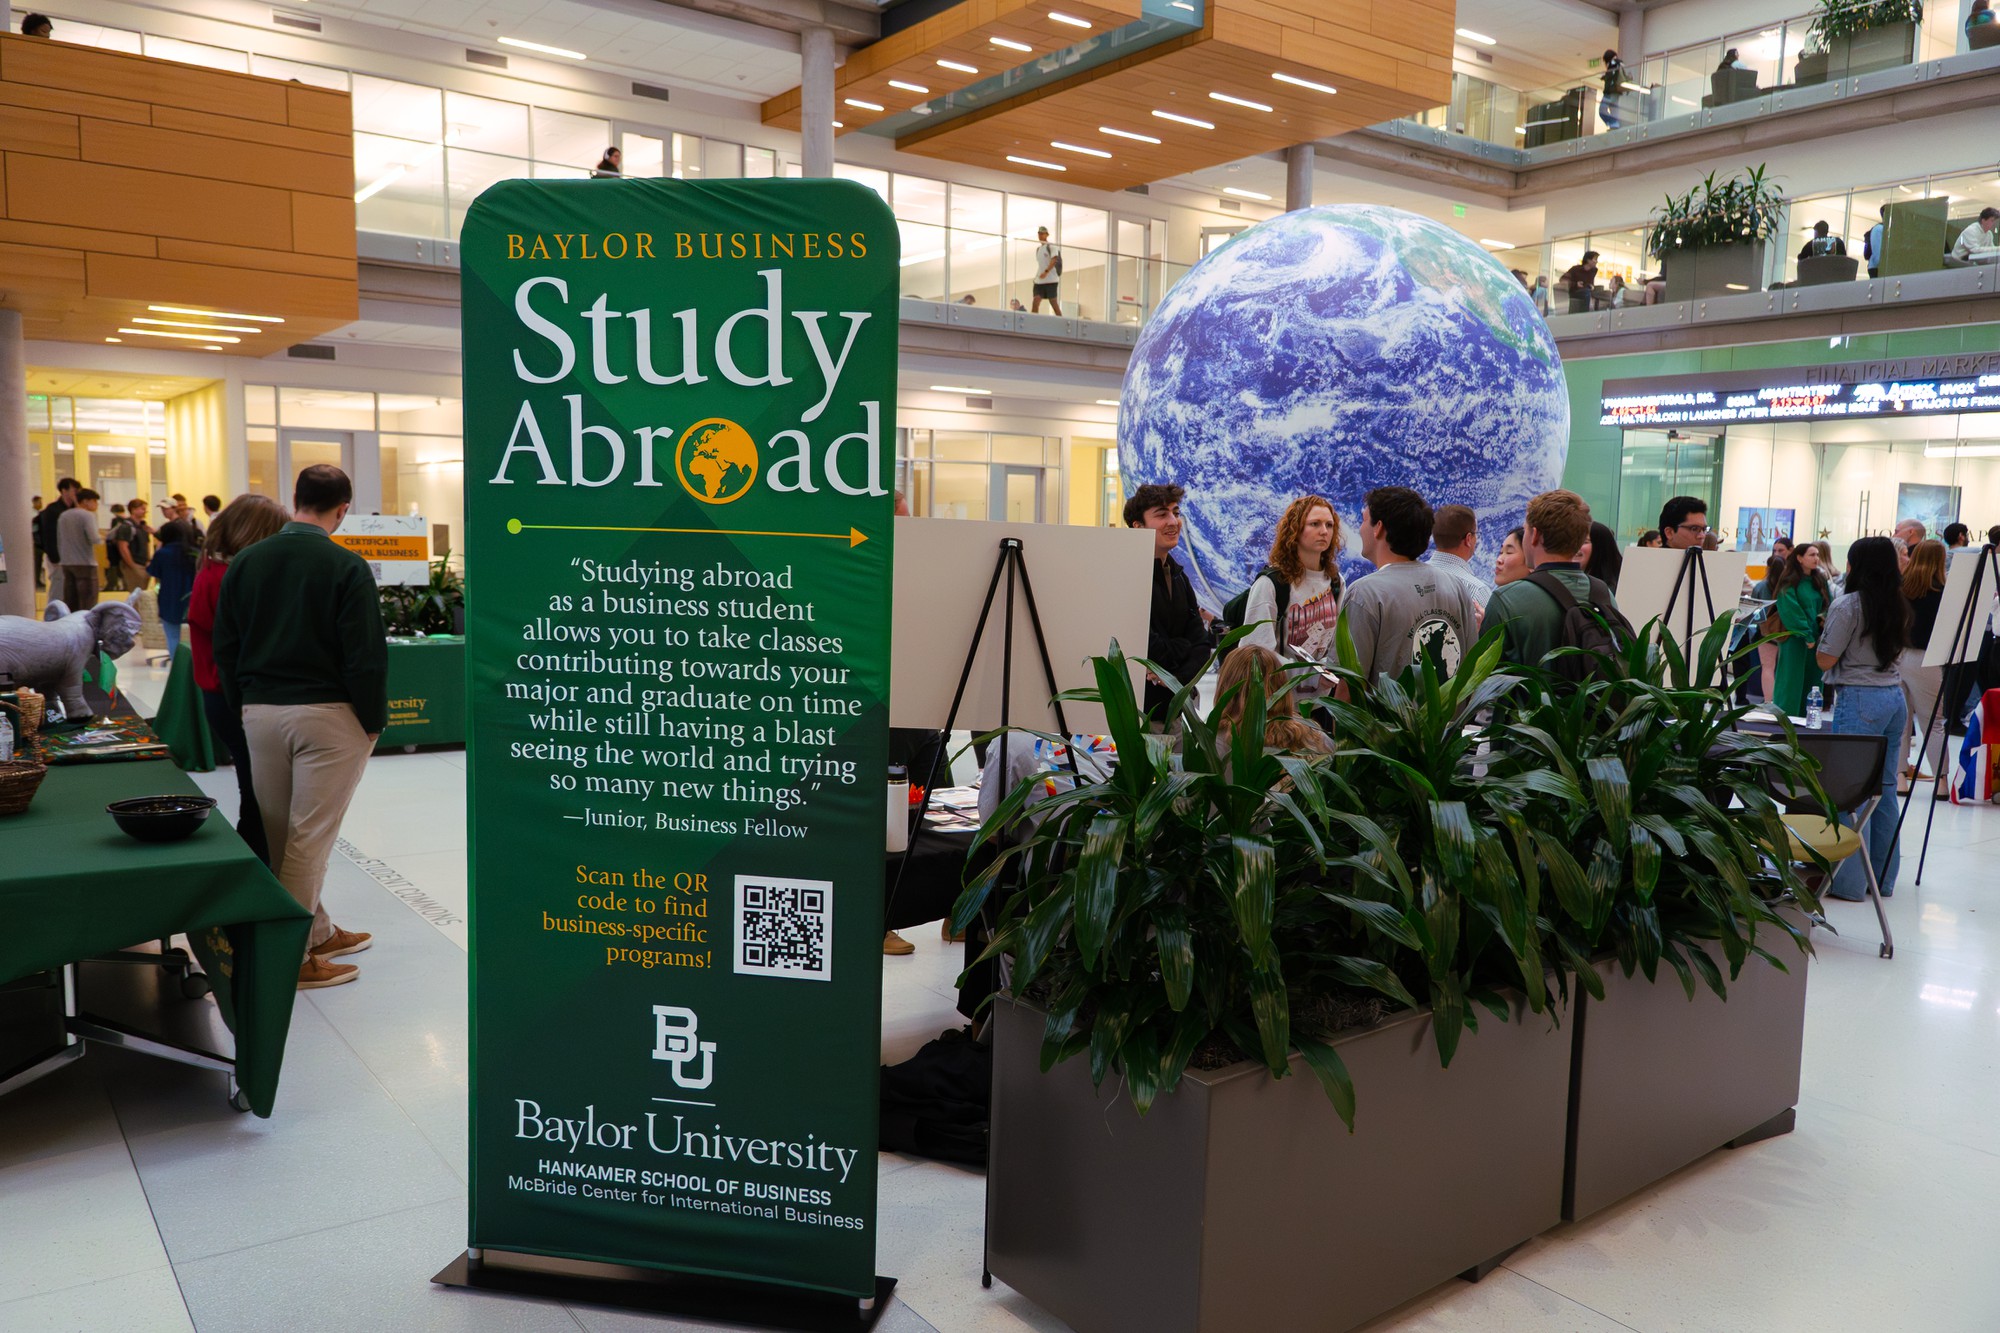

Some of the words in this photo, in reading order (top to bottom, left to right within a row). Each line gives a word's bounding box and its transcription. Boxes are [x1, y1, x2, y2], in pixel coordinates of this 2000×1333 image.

[507, 232, 656, 260] BAYLOR
[674, 232, 867, 259] BUSINESS
[512, 268, 872, 423] Study
[343, 538, 399, 546] CERTIFICATE
[376, 549, 419, 558] BUSINESS
[702, 562, 793, 590] abroad
[549, 594, 573, 612] as
[581, 596, 595, 613] a
[602, 588, 709, 617] business
[717, 595, 816, 622] student
[1424, 608, 1461, 630] CLASSROOMS
[523, 617, 601, 643] allows
[607, 627, 656, 650] you
[663, 626, 689, 647] to
[697, 624, 751, 650] take
[759, 626, 843, 654] classes
[516, 649, 674, 683] contributing
[680, 657, 782, 682] towards
[789, 666, 851, 689] your
[505, 678, 579, 707] major
[586, 681, 634, 705] and
[641, 684, 752, 713] graduate
[759, 695, 794, 713] on
[802, 691, 862, 716] time
[528, 707, 598, 733] while
[605, 712, 650, 736] still
[659, 713, 745, 748] having
[752, 725, 767, 743] a
[774, 719, 837, 746] blast
[510, 737, 588, 769] seeing
[594, 740, 634, 765] the
[641, 744, 715, 770] world
[723, 749, 772, 773] and
[780, 752, 857, 785] trying
[550, 774, 577, 791] so
[585, 776, 655, 802] many
[662, 781, 715, 799] new
[655, 812, 738, 835] Business
[743, 818, 809, 838] Fellow
[356, 859, 414, 888] STUDENT
[394, 888, 463, 927] COMMONS
[576, 864, 625, 886] Scan
[632, 868, 666, 890] the
[673, 872, 709, 896] QR
[577, 891, 628, 912] code
[634, 897, 656, 914] to
[663, 895, 708, 918] find
[543, 911, 708, 944] business-specific
[606, 947, 712, 969] programs!
[515, 1098, 638, 1154] Baylor
[644, 1112, 859, 1184] University
[538, 1158, 637, 1184] HANKAMER
[640, 1170, 712, 1193] SCHOOL
[715, 1178, 740, 1195] OF
[744, 1181, 832, 1206] BUSINESS
[508, 1175, 577, 1196] McBride
[582, 1183, 637, 1202] Center
[641, 1189, 666, 1205] for
[671, 1192, 779, 1219] International
[784, 1206, 864, 1230] Business
